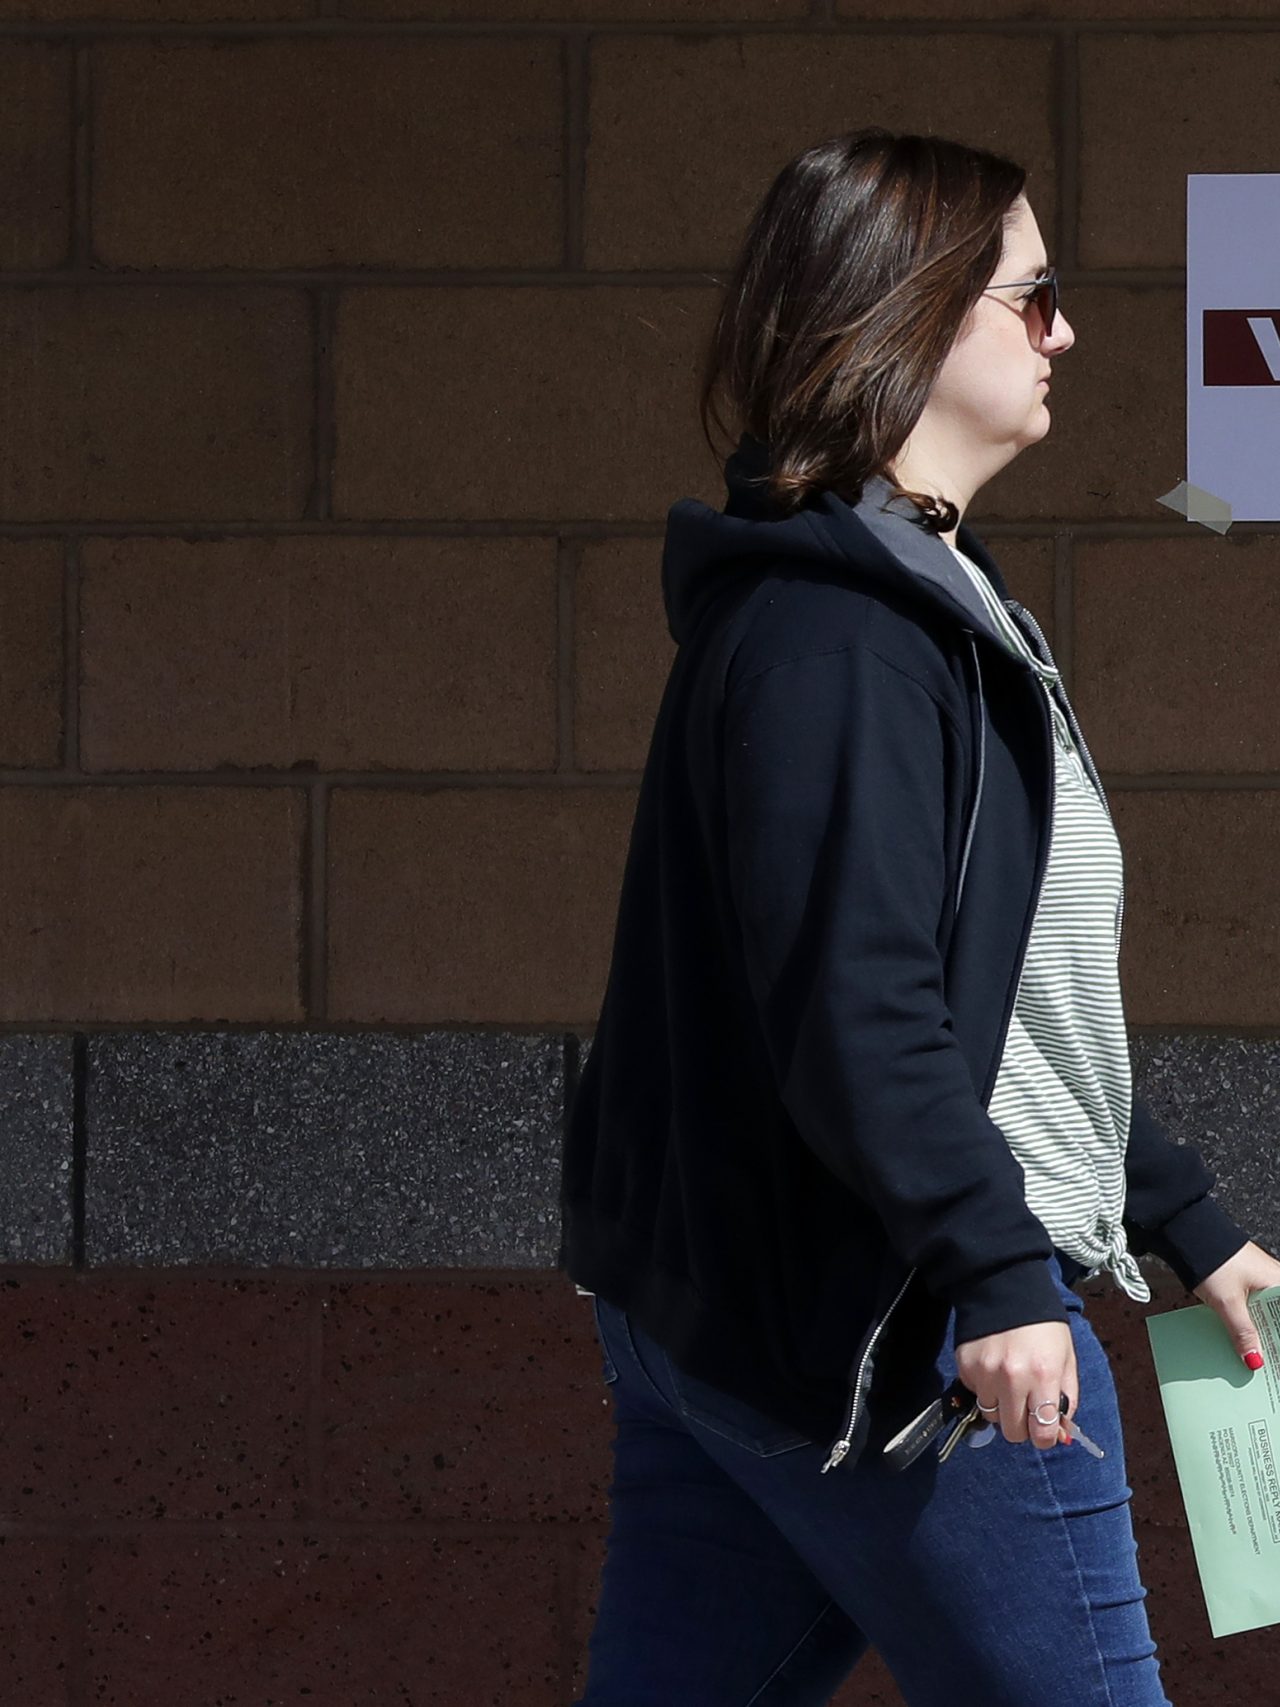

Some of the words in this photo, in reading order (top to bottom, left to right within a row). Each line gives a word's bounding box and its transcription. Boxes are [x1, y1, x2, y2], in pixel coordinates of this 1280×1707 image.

[1229, 1427, 1239, 1457] MARICOPA
[1236, 1458, 1244, 1482] COUNTY
[1241, 1483, 1252, 1515] ELECTIONS
[1248, 1516, 1260, 1555] DEPARTMENT
[1258, 1428, 1274, 1476] BUSINESS
[1268, 1476, 1280, 1508] REPLY
